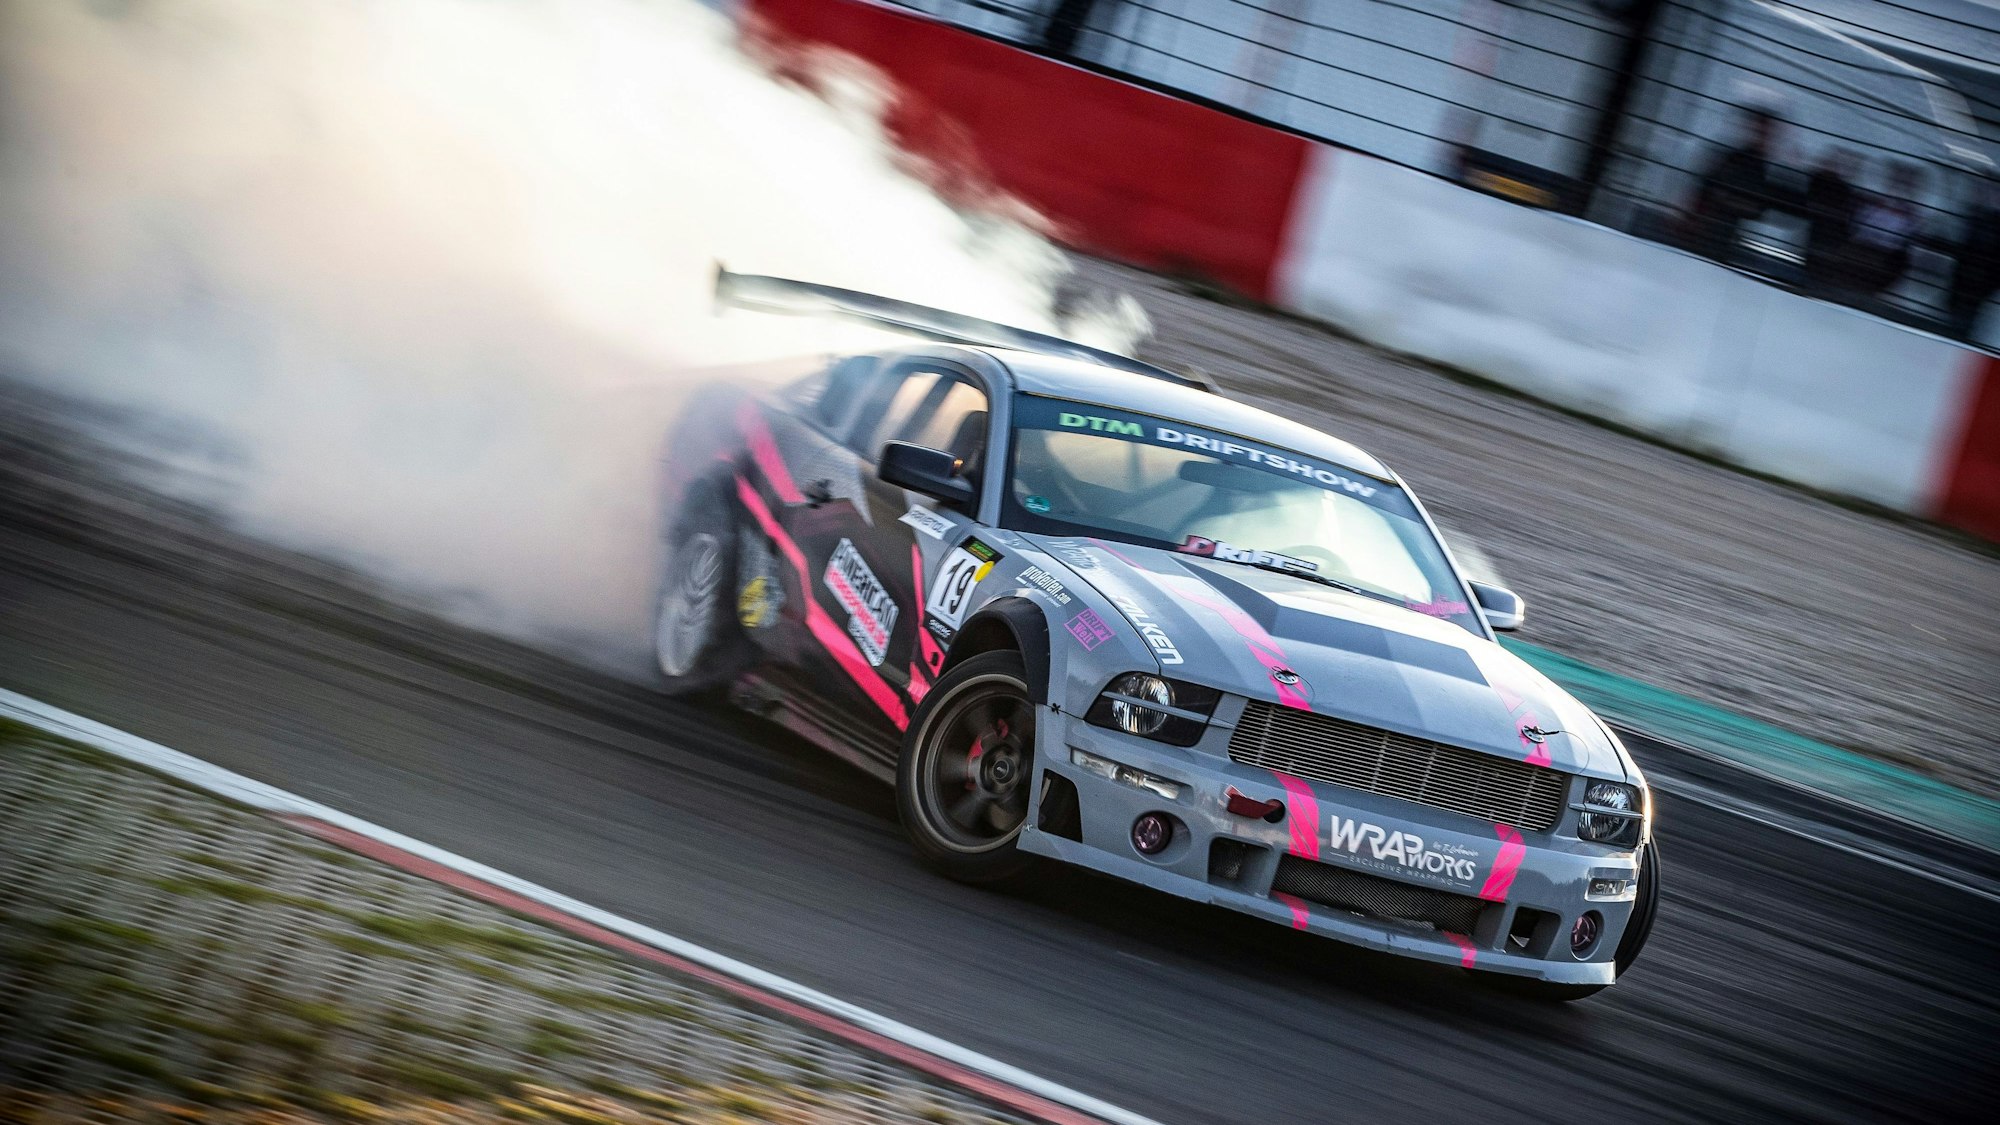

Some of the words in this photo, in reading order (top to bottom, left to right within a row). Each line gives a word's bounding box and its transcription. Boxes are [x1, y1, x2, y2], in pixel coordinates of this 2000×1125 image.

[1058, 412, 1145, 437] DTM
[1156, 427, 1378, 498] DRIFTSHOW
[938, 558, 976, 615] 19
[1080, 609, 1113, 638] DRIFT
[1331, 814, 1424, 867] WRAP
[1408, 850, 1477, 881] WORKS
[1350, 856, 1401, 874] EXCLUSIVE
